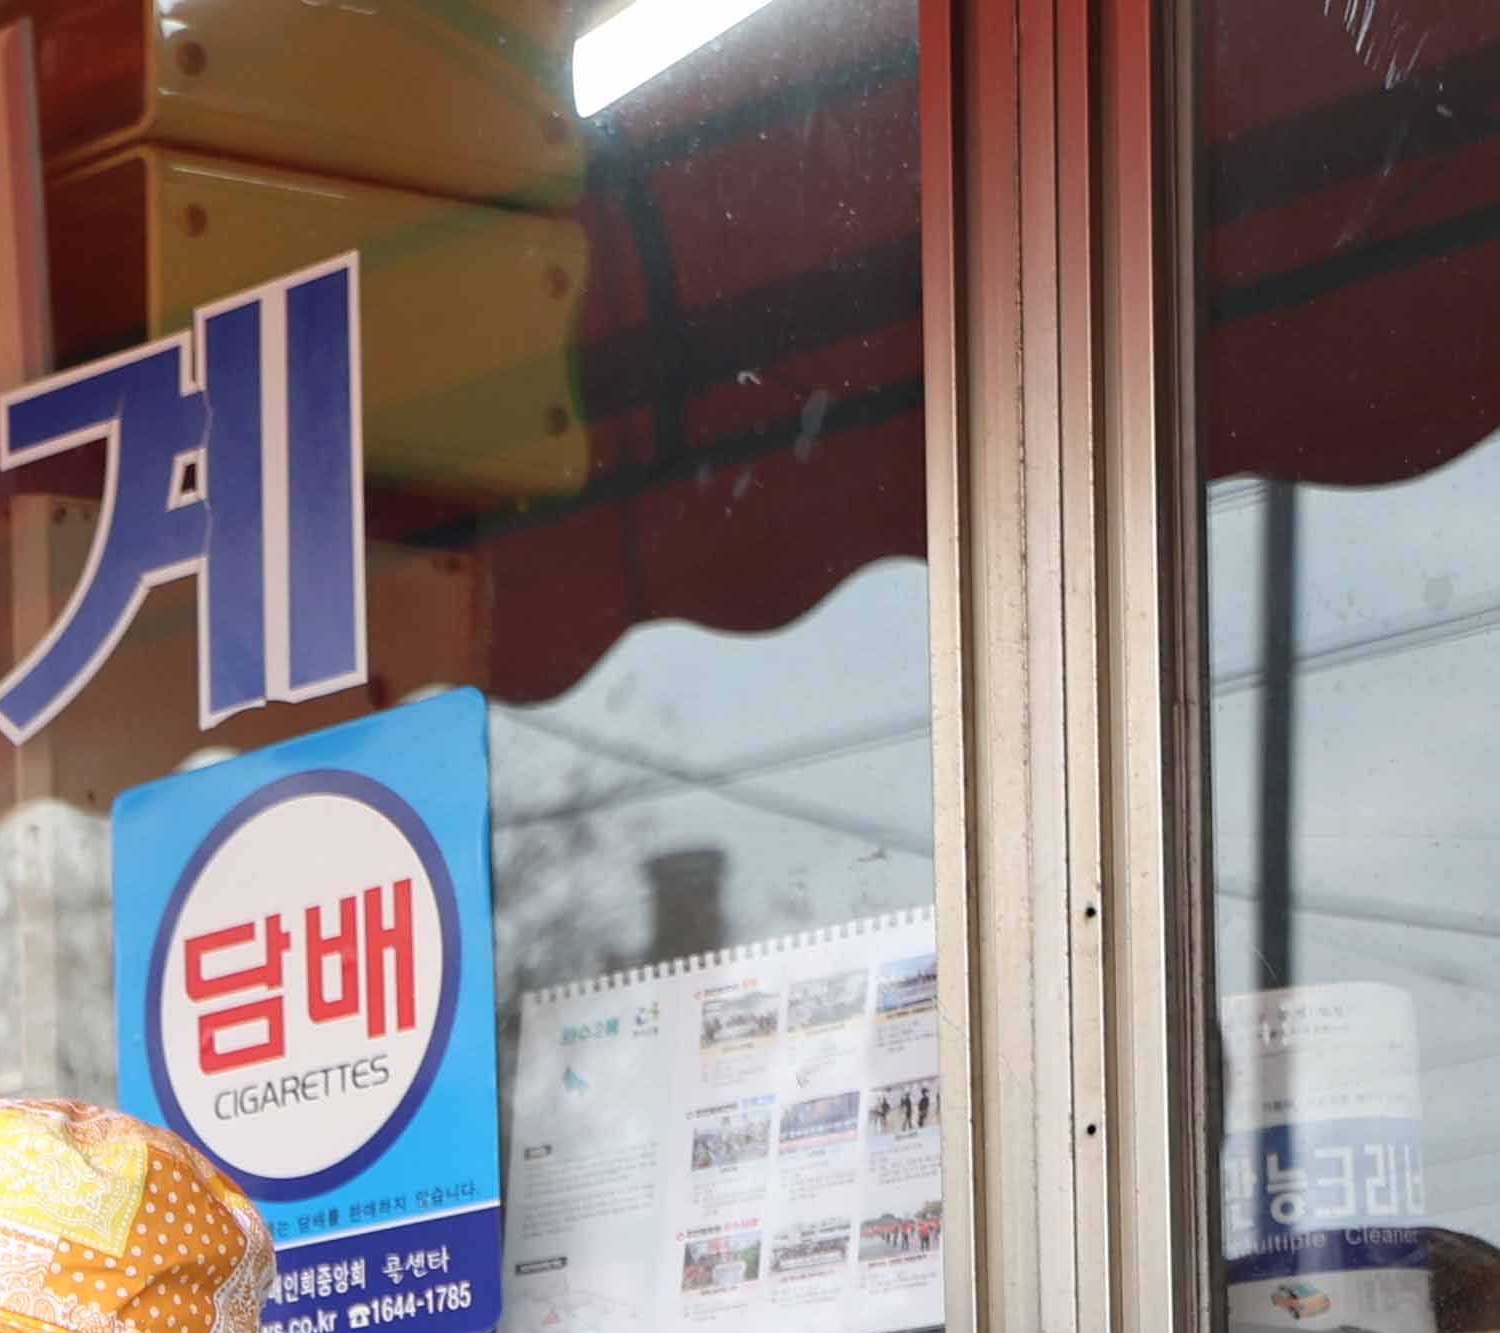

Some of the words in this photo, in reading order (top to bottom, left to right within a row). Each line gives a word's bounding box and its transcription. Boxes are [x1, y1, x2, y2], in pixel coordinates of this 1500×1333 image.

[184, 877, 417, 1076] 담배
[213, 1054, 391, 1121] CIGARETTES
[1242, 1232, 1325, 1257] ultiple
[1344, 1224, 1420, 1247] Cleaner
[381, 1244, 450, 1285] 콜센타
[371, 1281, 473, 1325] 1644-1785
